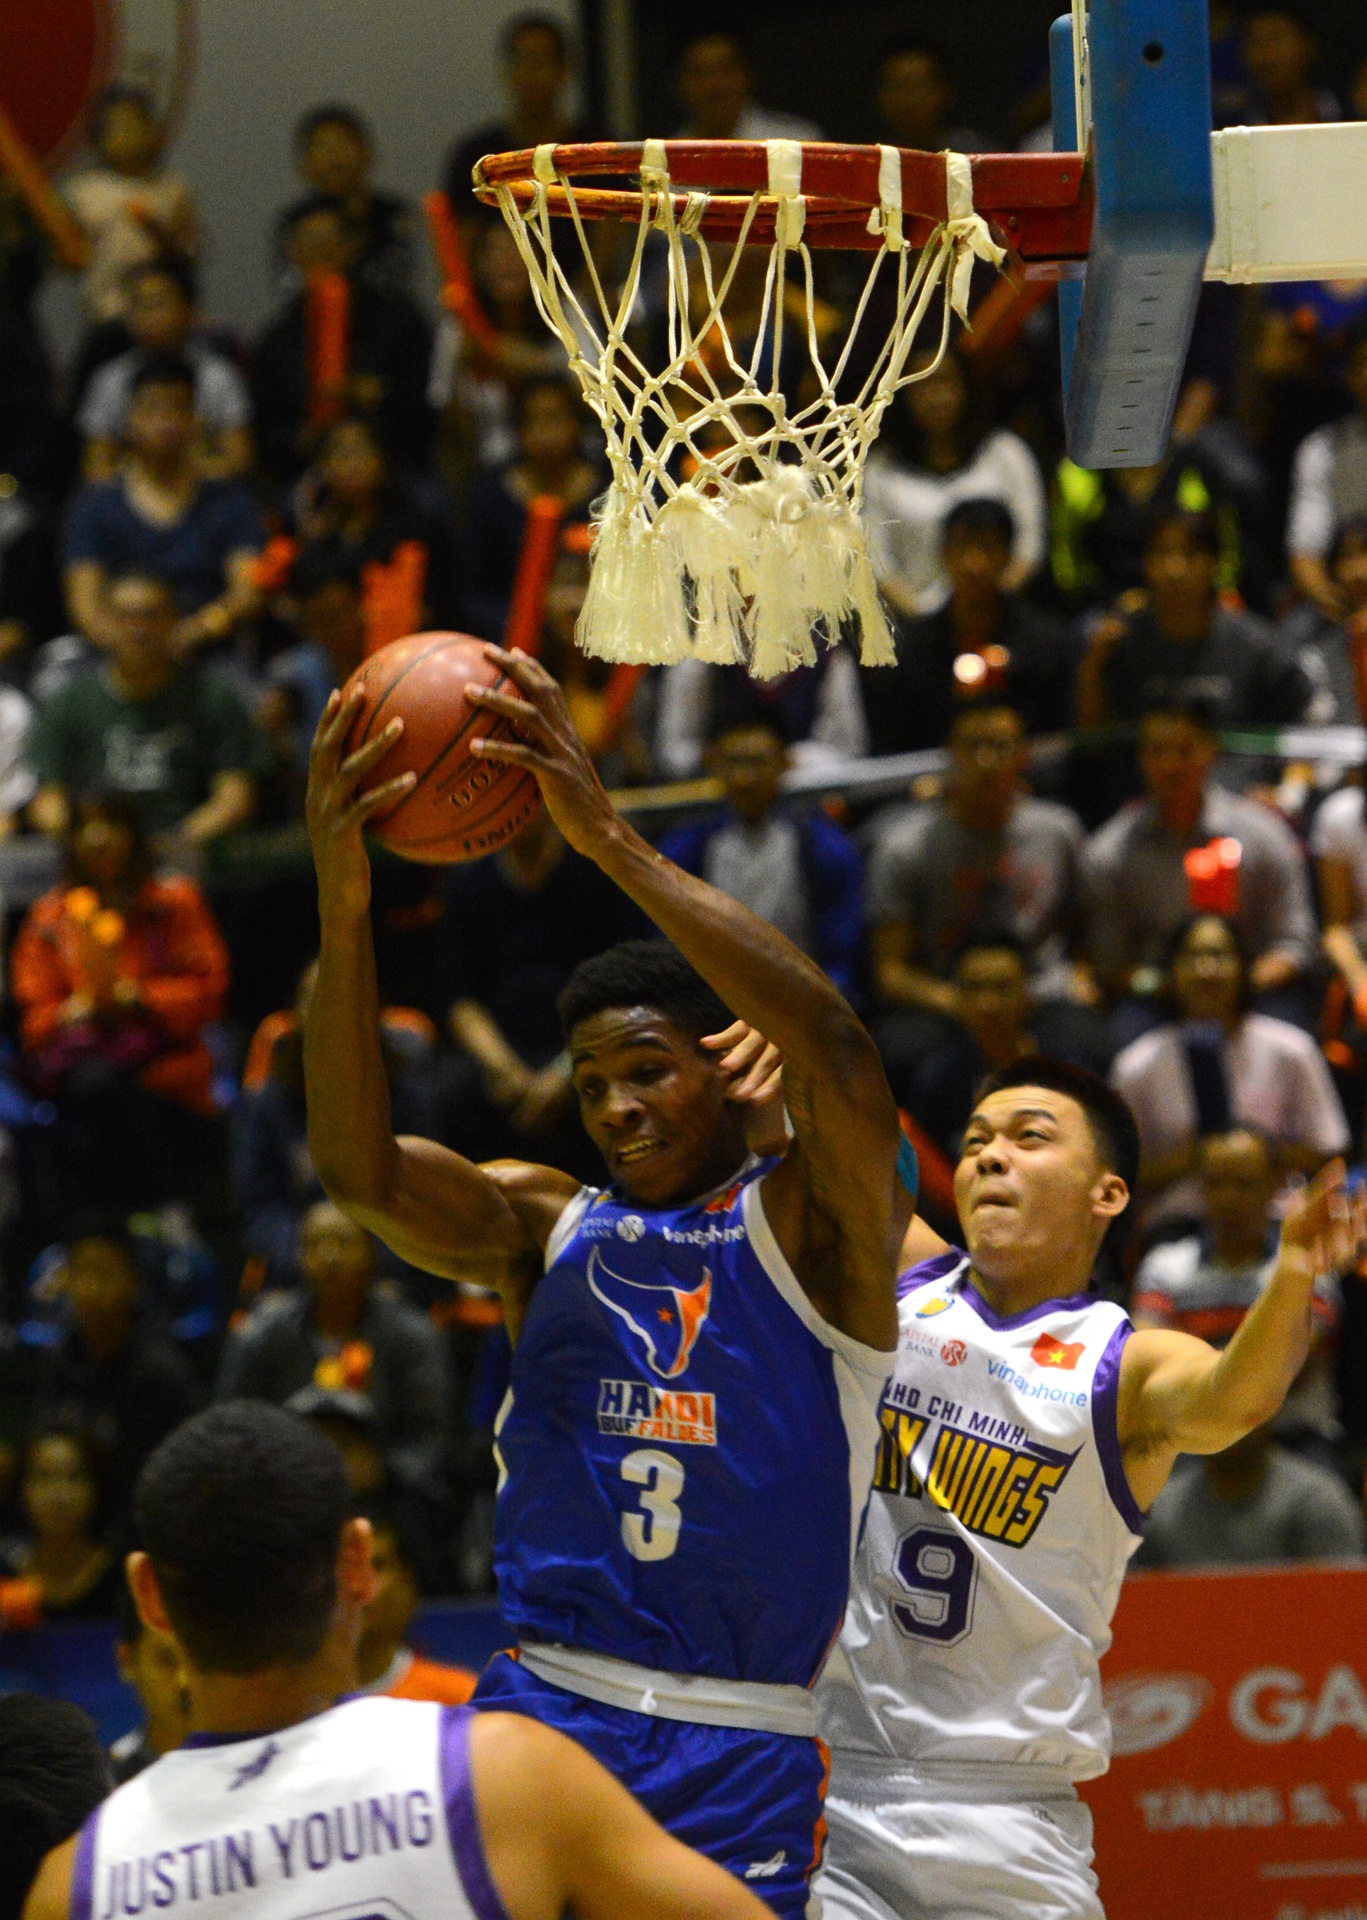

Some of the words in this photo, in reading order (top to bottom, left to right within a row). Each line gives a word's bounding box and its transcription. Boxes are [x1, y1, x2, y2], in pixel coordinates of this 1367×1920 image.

[601, 1382, 714, 1427] HANOI
[927, 1395, 963, 1424] CHI
[968, 1411, 1025, 1446] MINH
[987, 1359, 1088, 1408] vinaphone
[620, 1448, 685, 1561] 3
[926, 1424, 1070, 1549] WINGS
[889, 1522, 979, 1648] 9
[103, 1830, 257, 1919] JUSTIN
[269, 1790, 433, 1878] YOUNG
